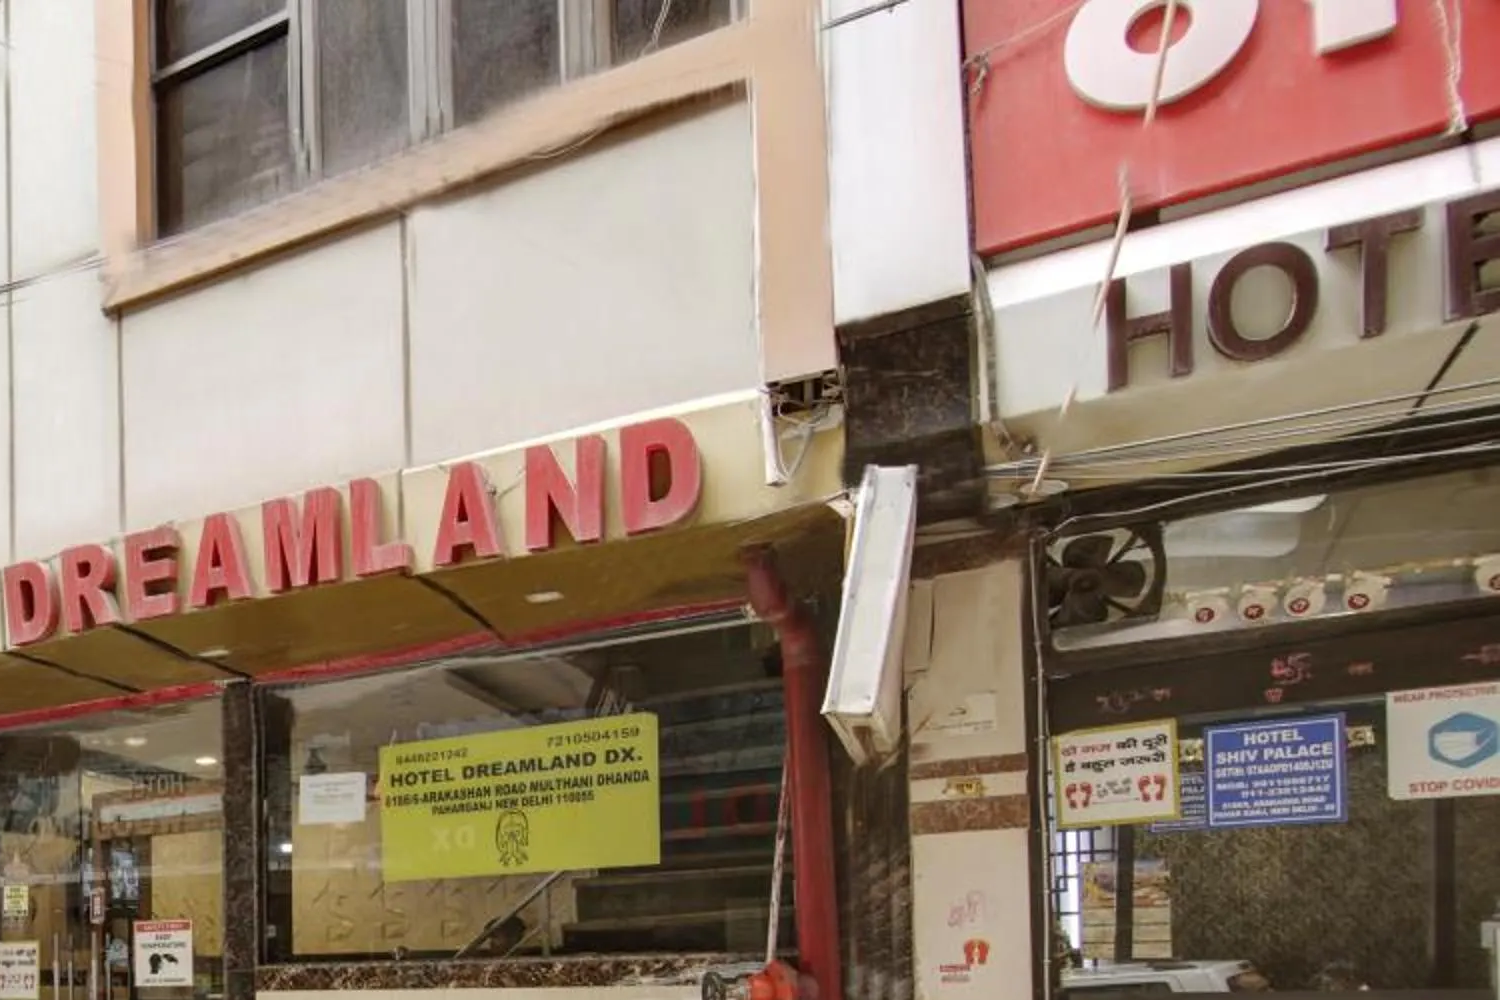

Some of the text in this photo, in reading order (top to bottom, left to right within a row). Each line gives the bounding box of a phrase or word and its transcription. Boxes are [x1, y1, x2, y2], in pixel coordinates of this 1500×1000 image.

[2, 416, 702, 647] DREAMLAND
[1243, 728, 1304, 746] HOTEL
[1215, 741, 1334, 766] SHIV PALACE
[390, 746, 643, 788] HOTEL DREAMLAND DX.
[495, 783, 527, 797] ROAD
[596, 769, 650, 786] DHANDA
[1409, 781, 1448, 794] STOP
[495, 798, 519, 810] NEW
[521, 794, 553, 808] DELHI
